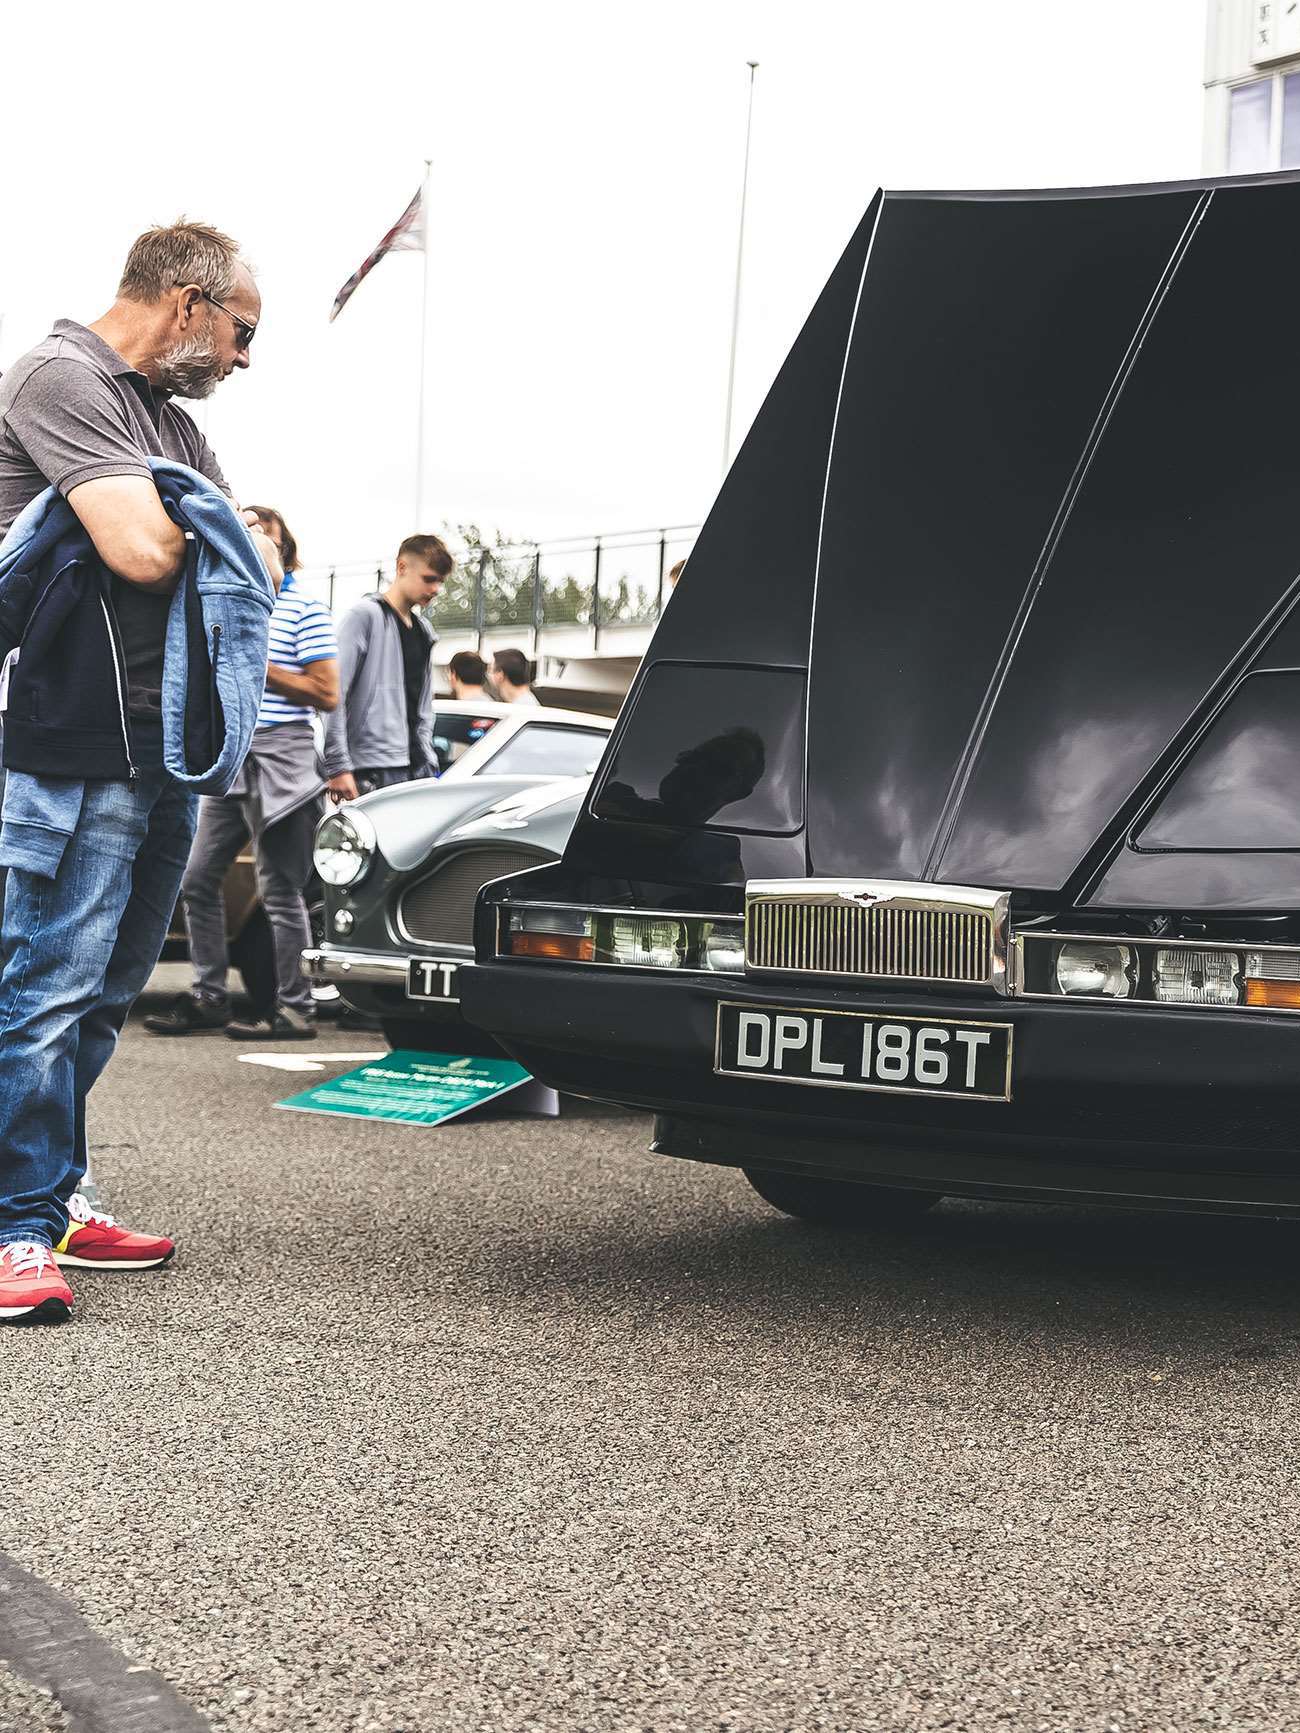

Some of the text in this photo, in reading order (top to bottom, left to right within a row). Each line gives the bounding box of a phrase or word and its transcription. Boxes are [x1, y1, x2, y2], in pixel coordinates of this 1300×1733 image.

[419, 961, 458, 997] TT
[736, 1011, 991, 1088] DPL 186T
